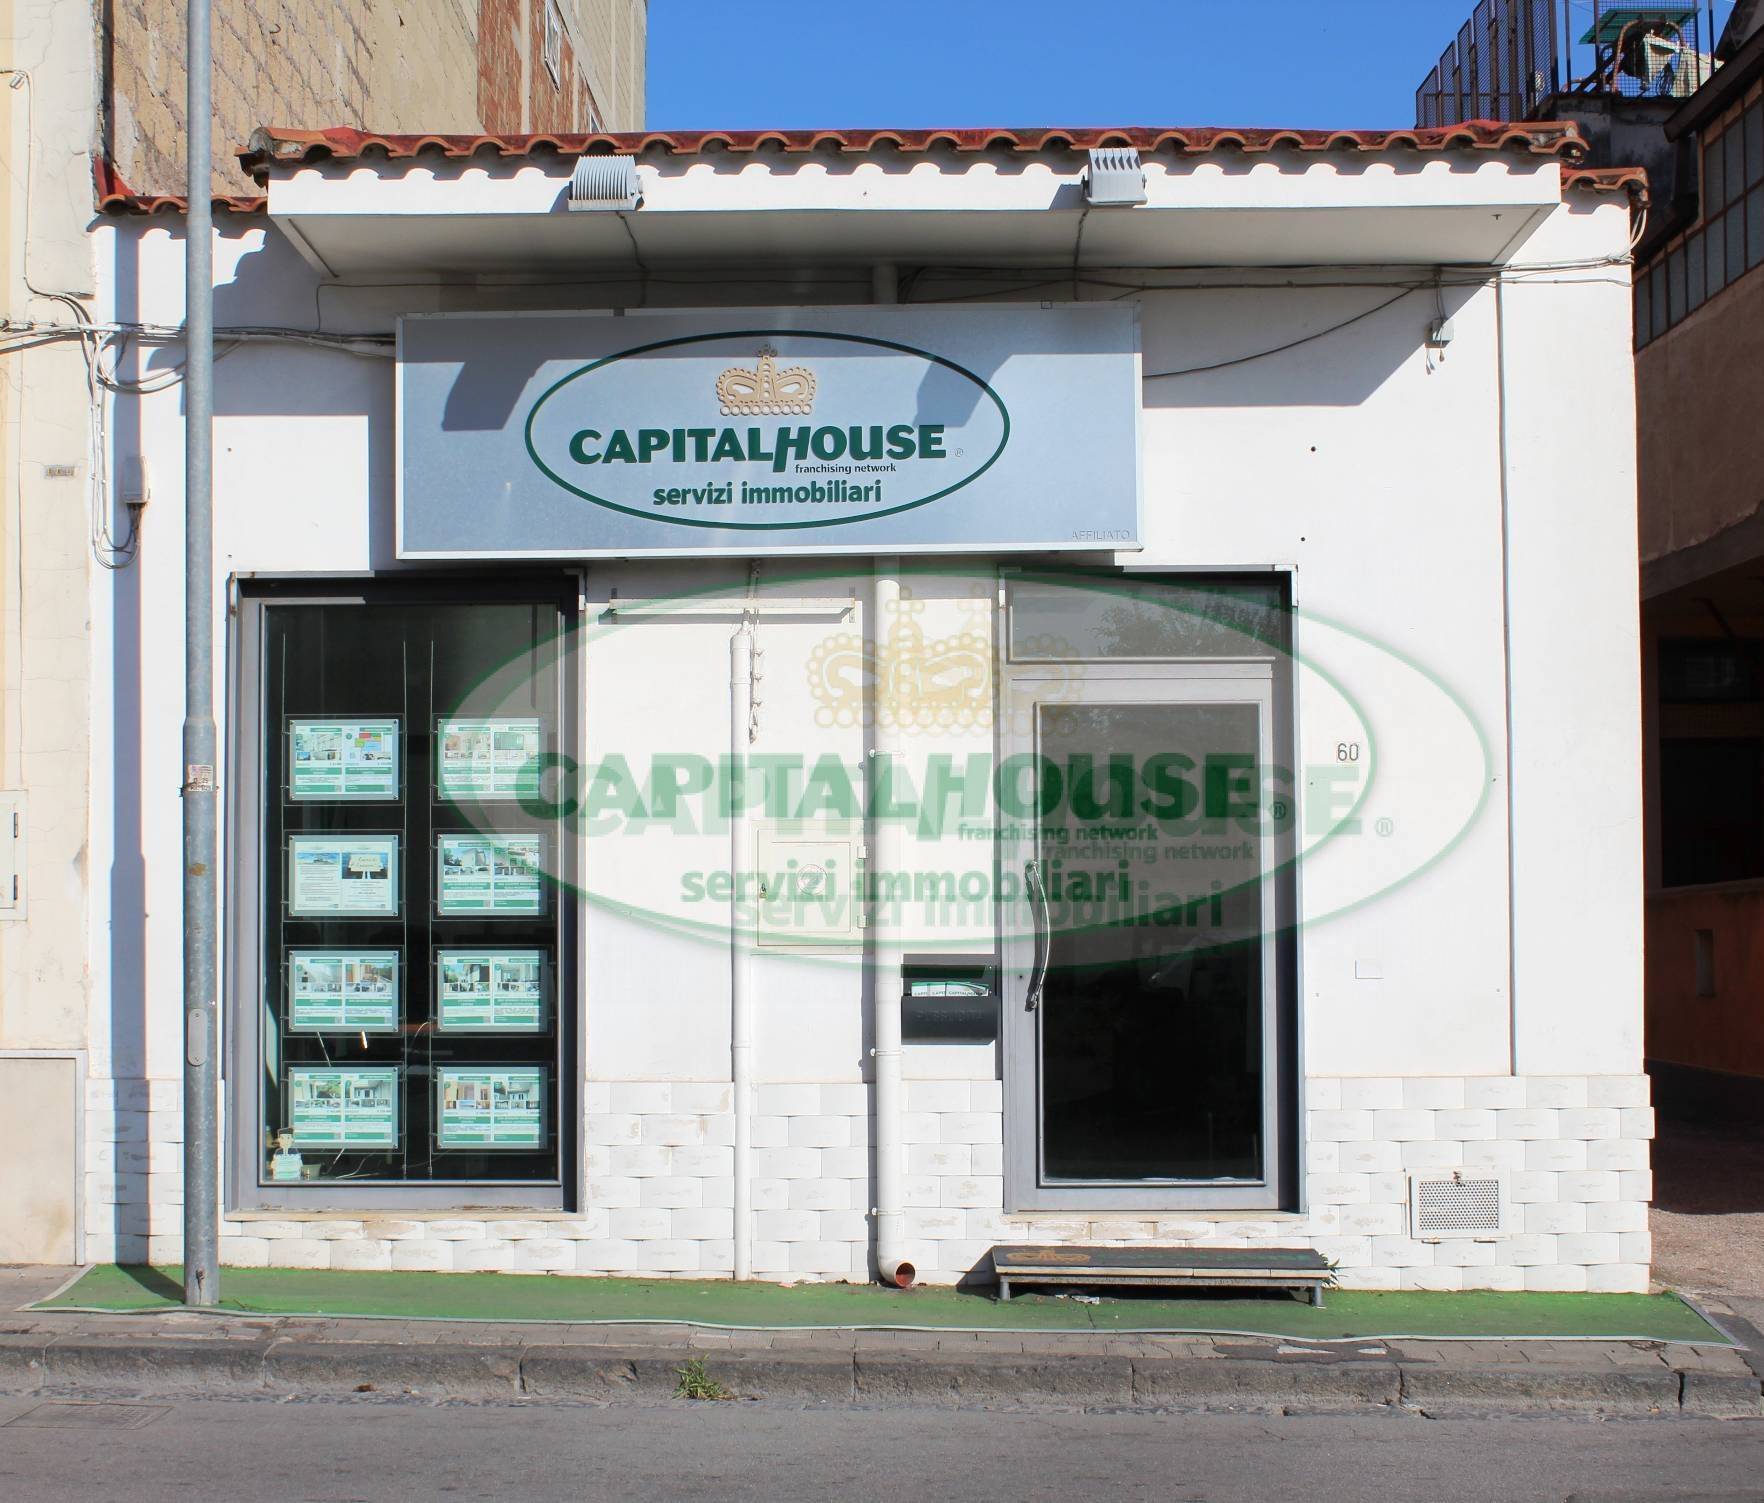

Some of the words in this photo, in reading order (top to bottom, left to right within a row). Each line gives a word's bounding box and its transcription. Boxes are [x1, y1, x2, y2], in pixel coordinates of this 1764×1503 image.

[569, 425, 947, 473] CAPITALHOUSE
[795, 463, 852, 475] franchising
[854, 462, 897, 473] network
[653, 481, 733, 505] servizi
[742, 479, 882, 504] immobiliari
[1072, 529, 1130, 540] AFFILIATO
[1337, 742, 1359, 761] 60
